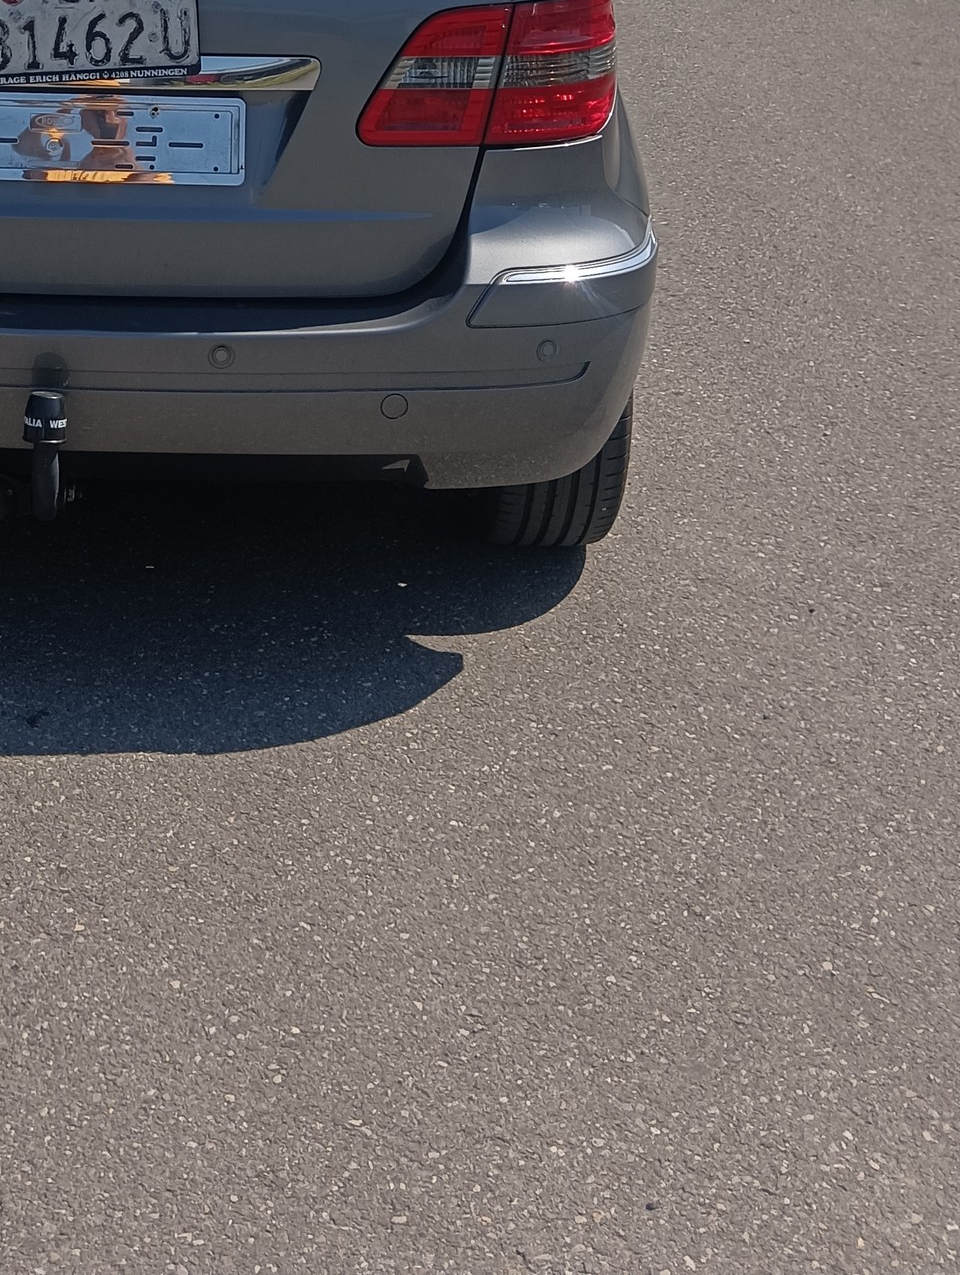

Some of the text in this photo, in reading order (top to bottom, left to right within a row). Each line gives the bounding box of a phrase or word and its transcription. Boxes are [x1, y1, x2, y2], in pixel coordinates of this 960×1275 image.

[29, 74, 60, 83] ERICH
[110, 71, 129, 79] 4208
[129, 68, 188, 78] NUNNINGEN
